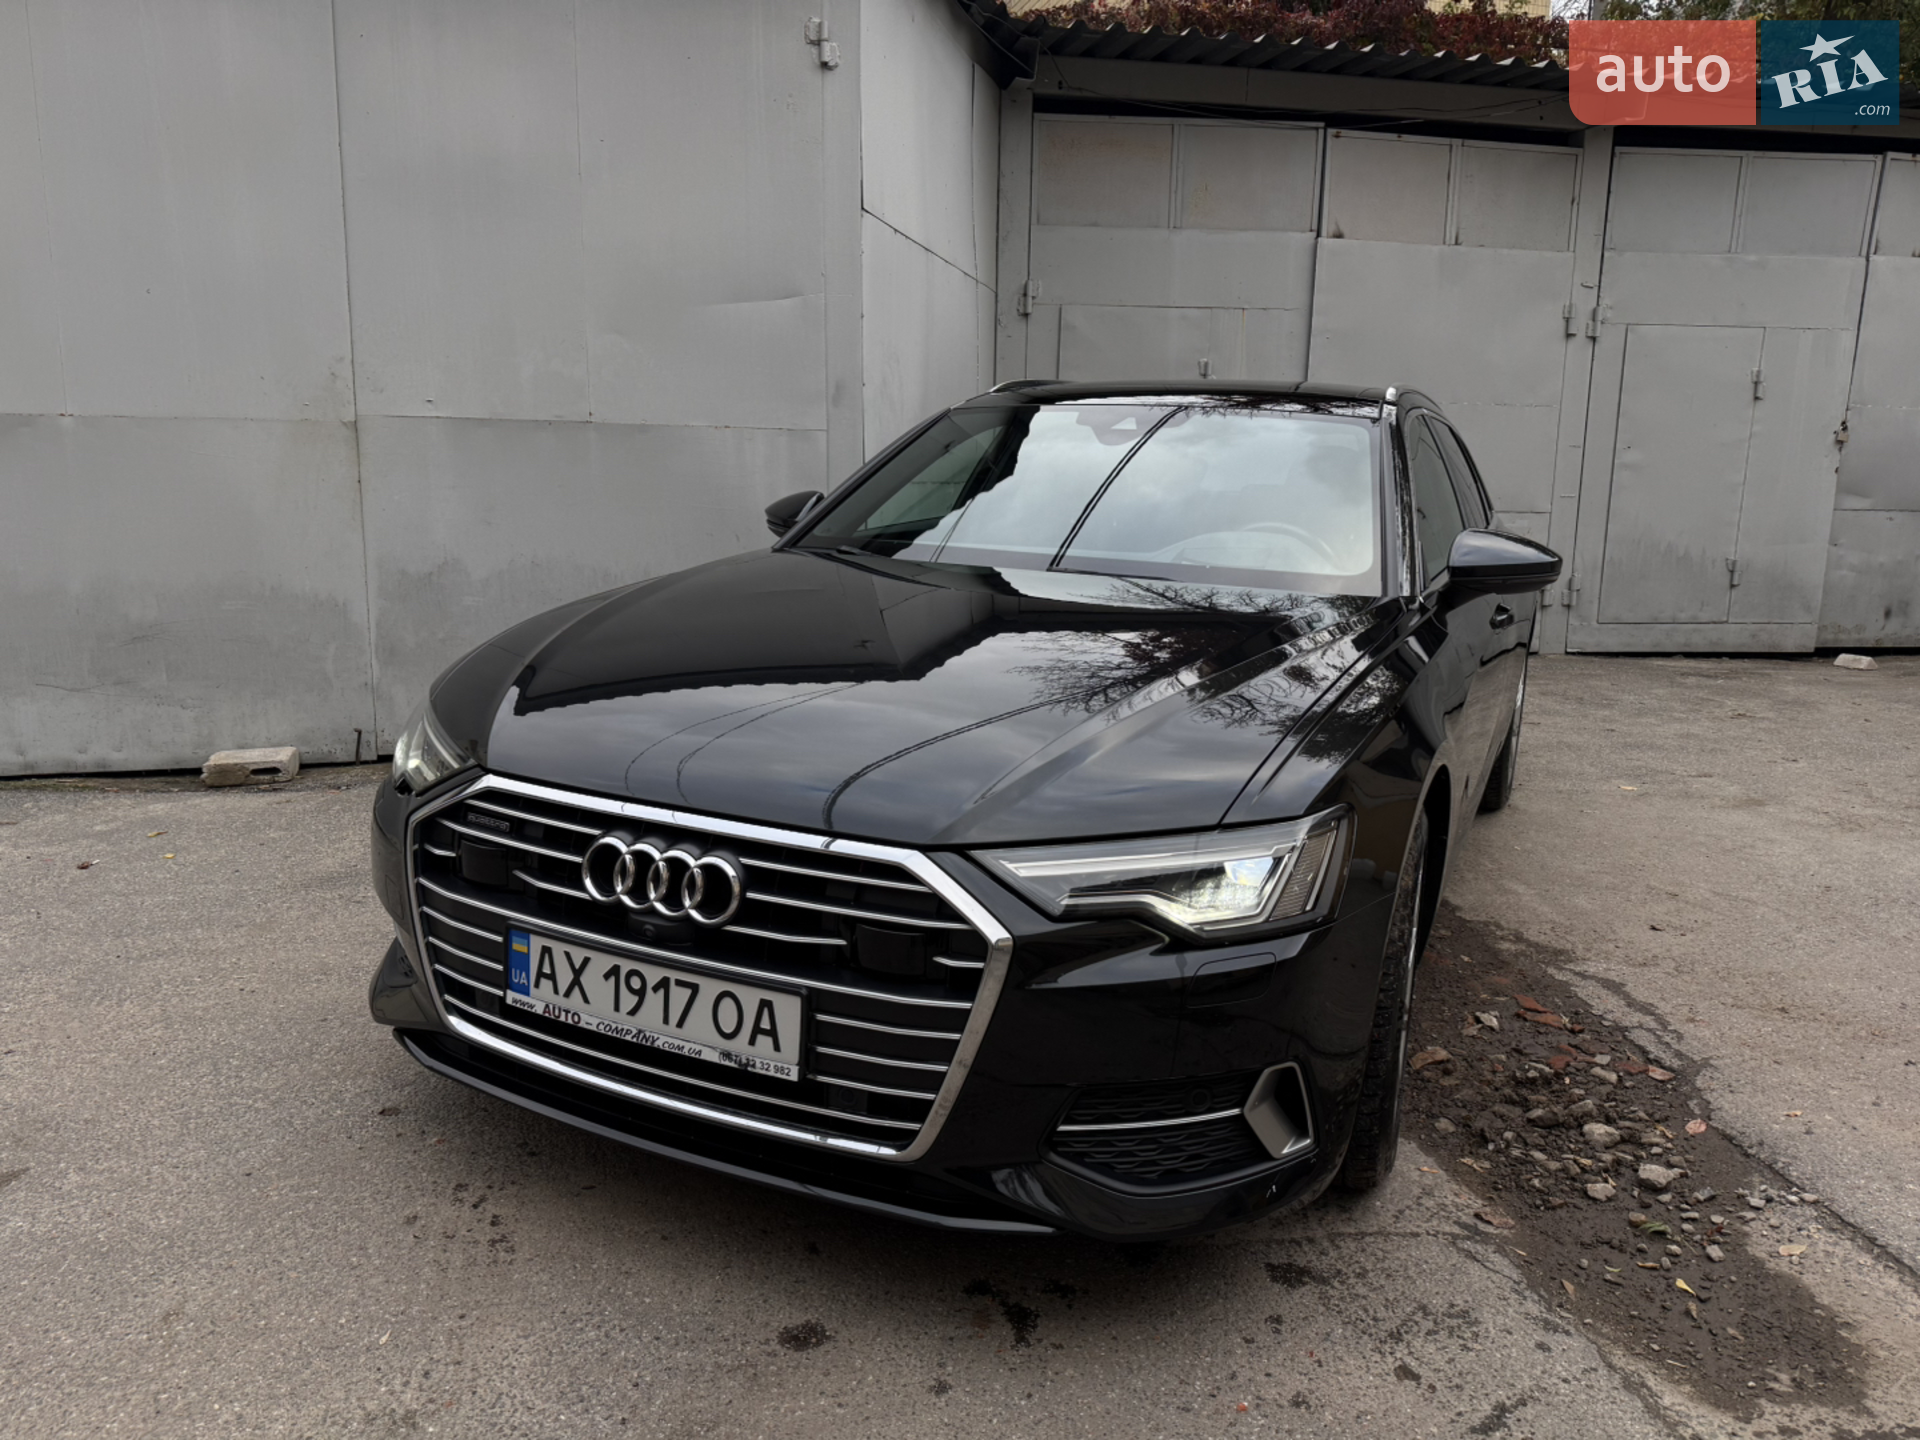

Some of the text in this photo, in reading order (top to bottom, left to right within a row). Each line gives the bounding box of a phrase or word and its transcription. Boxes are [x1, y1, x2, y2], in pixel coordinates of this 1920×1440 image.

[511, 969, 528, 986] UA
[533, 945, 782, 1052] AX 1917 OA
[542, 1004, 581, 1024] AUTO
[758, 1061, 771, 1072] 32
[773, 1064, 792, 1076] 982
